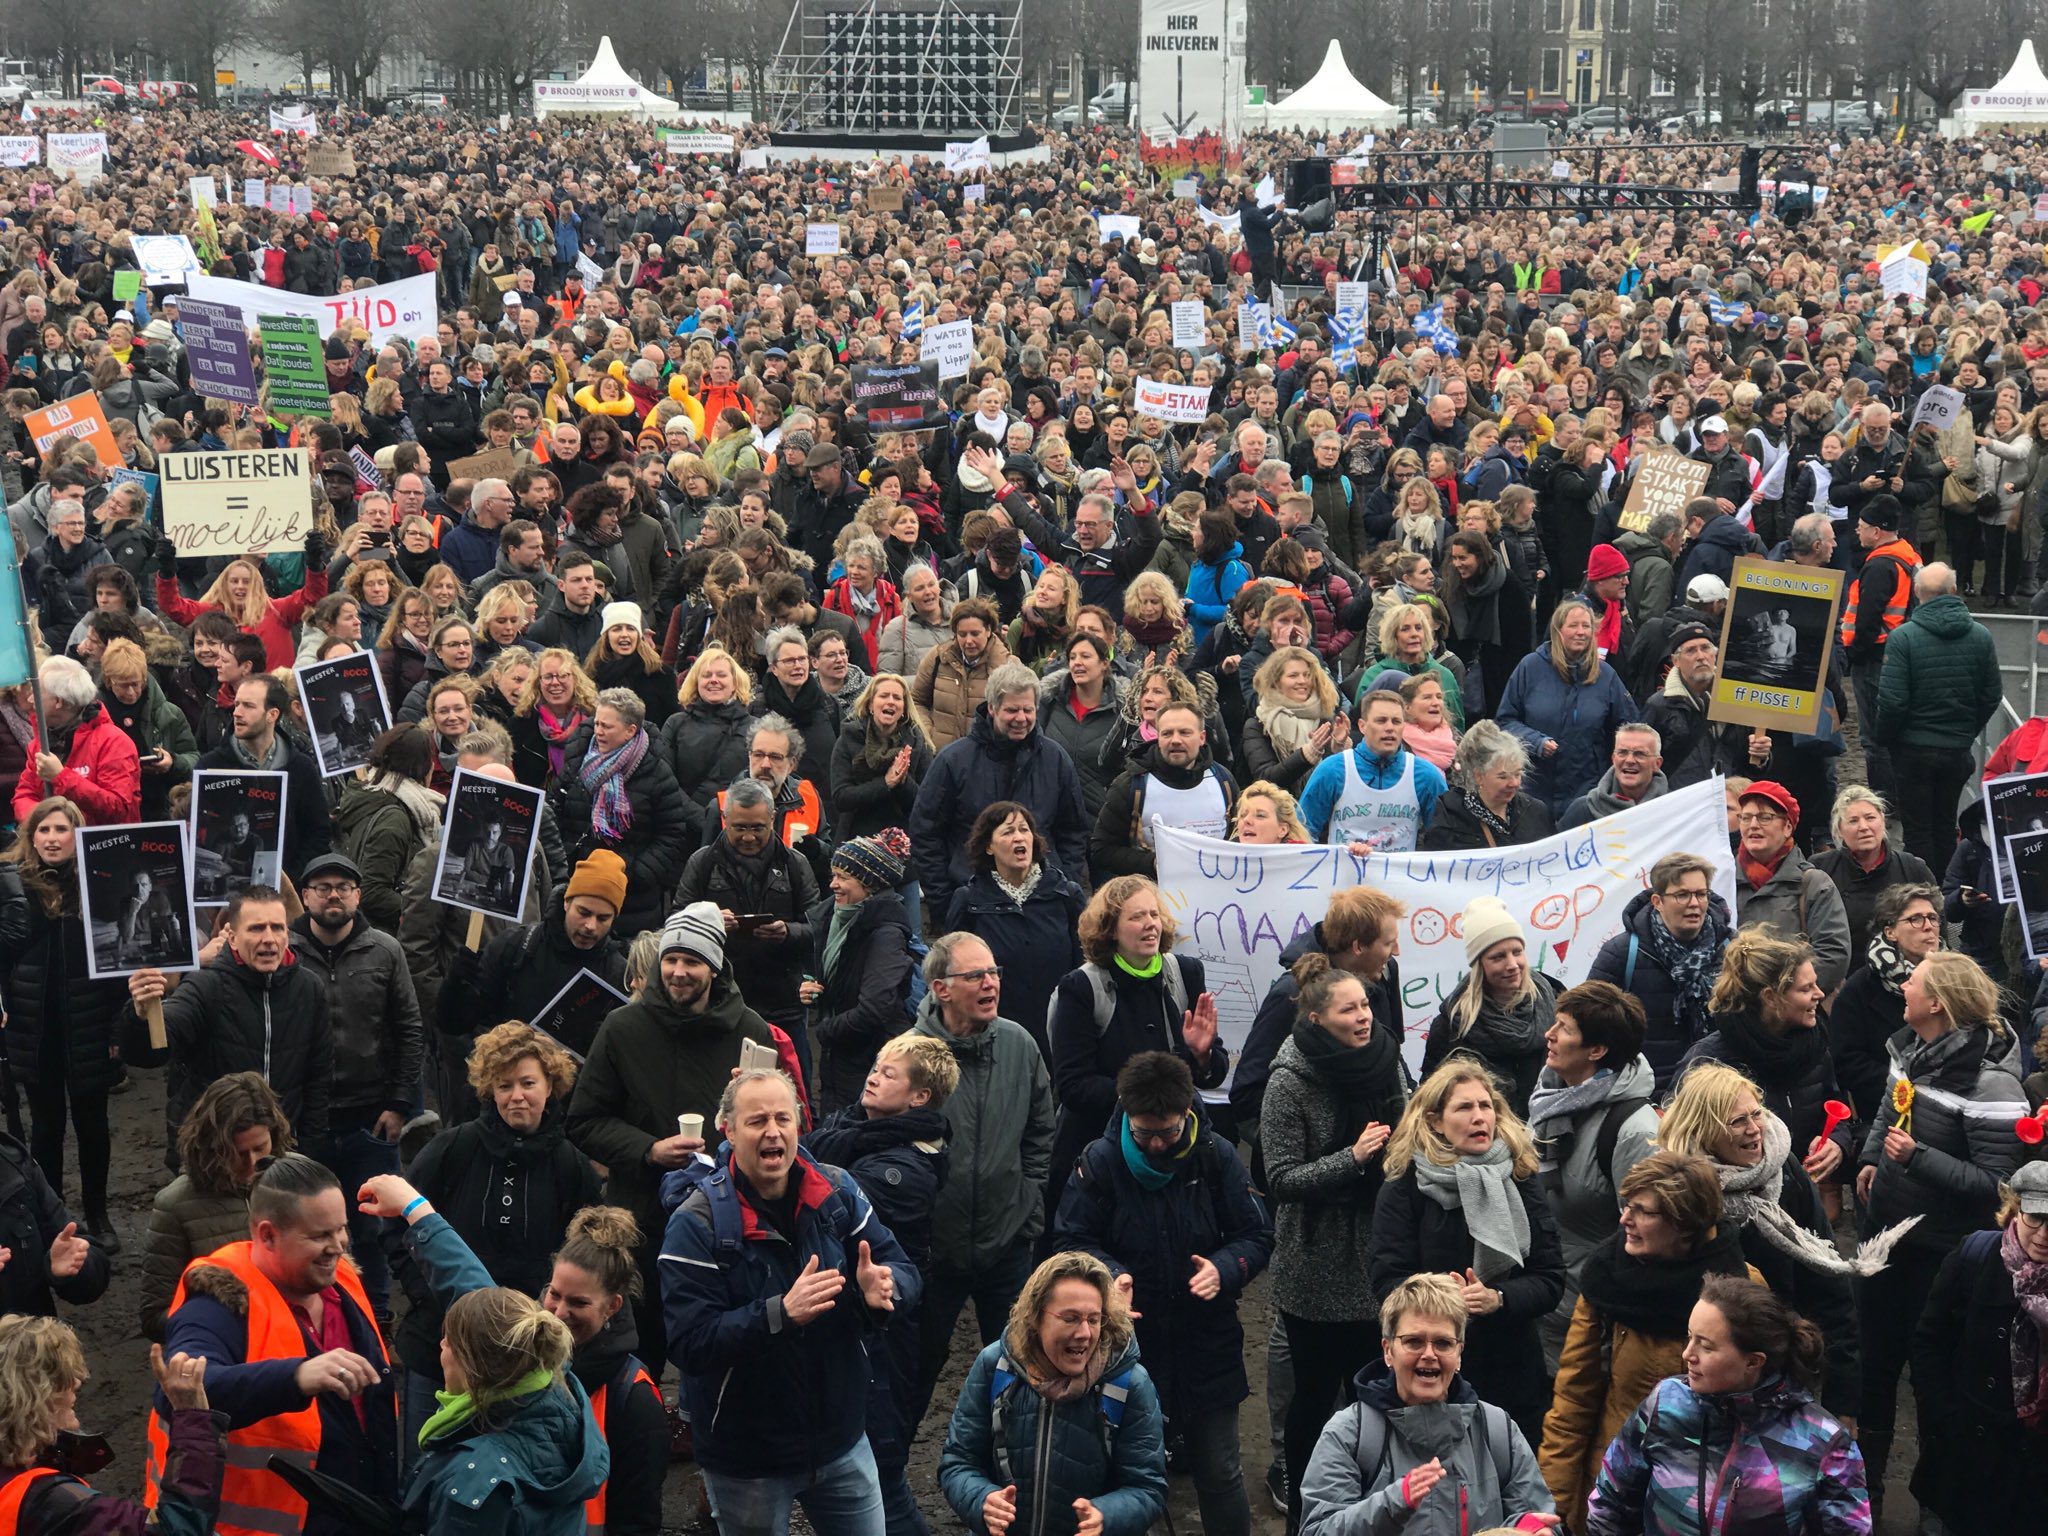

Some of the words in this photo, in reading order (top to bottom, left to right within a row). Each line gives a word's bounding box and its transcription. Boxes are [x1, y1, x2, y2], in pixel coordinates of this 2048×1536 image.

[1167, 15, 1198, 30] HIER
[1146, 35, 1219, 51] INLEVEREN
[550, 87, 591, 97] BROODJE
[593, 88, 625, 97] WORST
[1985, 96, 2033, 107] BROODJE
[180, 302, 225, 318] KINDEREN
[210, 317, 243, 331] WILLEN
[306, 323, 316, 332] in
[934, 327, 968, 341] WATER
[186, 337, 205, 348] DAN
[210, 341, 236, 353] MOET
[200, 361, 211, 371] ER
[216, 364, 235, 376] WEL
[265, 356, 280, 366] Dat
[282, 358, 312, 370] zouden
[197, 381, 230, 395] SCHOOL
[269, 377, 291, 387] meer
[854, 378, 907, 398] klimaat
[1161, 409, 1178, 418] goed
[163, 453, 299, 481] LUISTEREN
[1639, 468, 1705, 497] STAAKT
[1644, 486, 1687, 507] VOOR
[165, 506, 307, 552] moeilijk
[1746, 573, 1829, 594] BELONING?
[305, 666, 335, 685] MEESTER
[342, 667, 369, 678] BOOS
[1735, 687, 1747, 701] ff
[1750, 690, 1791, 708] PISSE
[204, 777, 242, 791] MEESTER
[247, 787, 277, 801] BOOS
[1994, 784, 2028, 801] MEESTER
[462, 785, 497, 794] MEESTER
[502, 797, 532, 817] BOOS
[89, 834, 131, 852] MEESTER
[141, 841, 176, 854] BOOS
[2024, 841, 2043, 857] JUF
[552, 1012, 565, 1030] JUF
[500, 1160, 518, 1225] ROXY
